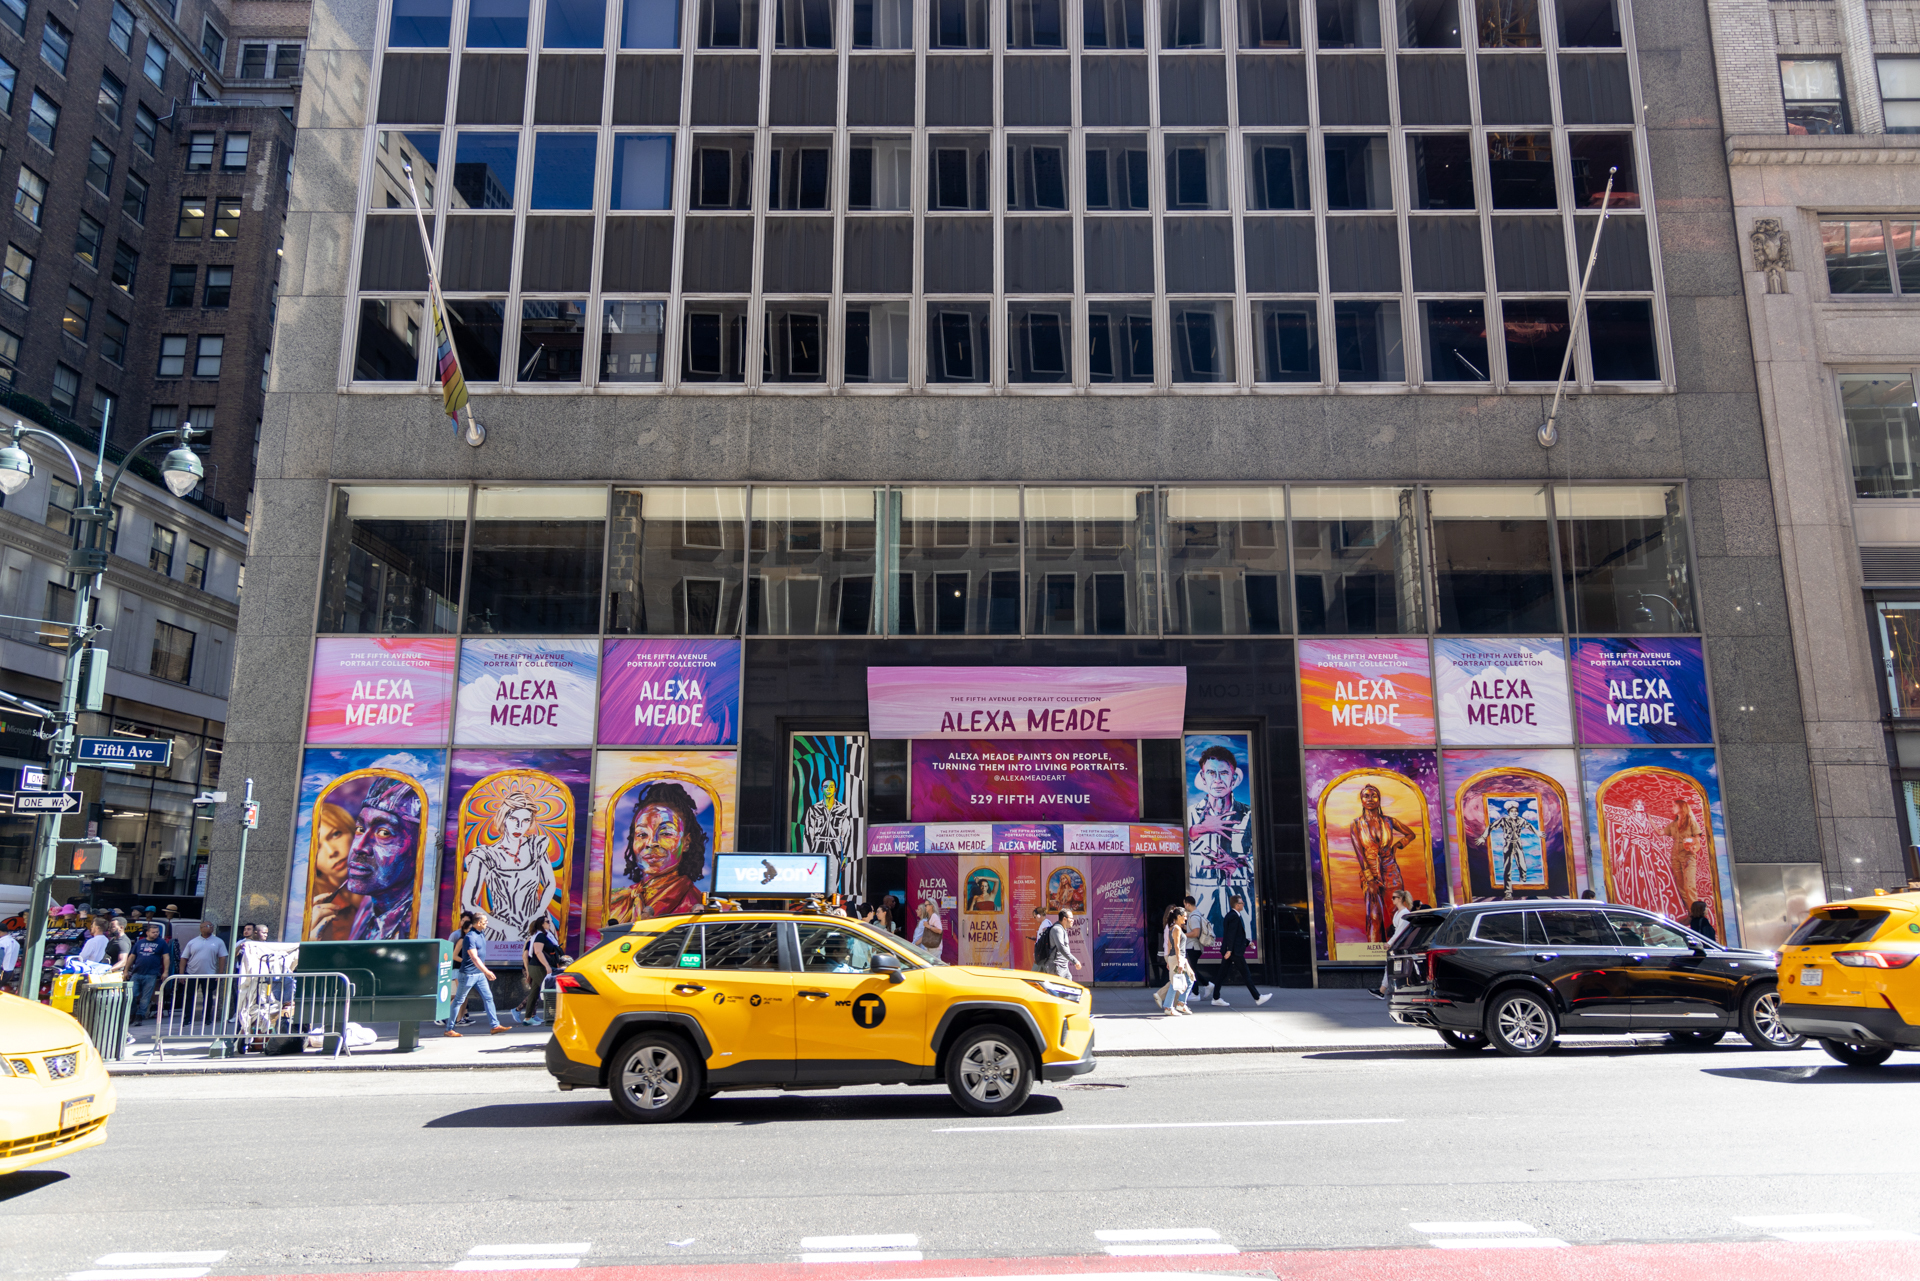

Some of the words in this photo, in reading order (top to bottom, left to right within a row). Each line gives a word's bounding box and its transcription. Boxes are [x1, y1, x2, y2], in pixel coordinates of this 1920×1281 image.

[352, 679, 414, 700] ALEXA
[496, 679, 558, 701] ALEXA
[640, 679, 701, 701] ALEXA
[1335, 679, 1397, 701] ALEXA
[1471, 678, 1533, 700] ALEXA
[1609, 678, 1672, 700] ALEXA
[346, 703, 415, 726] MEADE
[491, 704, 559, 727] MEADE
[635, 704, 703, 727] MEADE
[941, 710, 1016, 732] ALEXA
[1027, 709, 1111, 732] MEADE
[1332, 704, 1401, 726] MEADE
[1468, 703, 1537, 726] MEADE
[1606, 703, 1677, 726] MEADE
[7, 725, 31, 736] Microsoft
[93, 744, 124, 757] Fifth
[128, 746, 153, 758] Ave
[1073, 753, 1111, 761] PEOPLE,
[979, 763, 1005, 771] THEM
[1070, 763, 1128, 771] PORTRAITS.
[32, 774, 45, 784] ONE
[24, 799, 43, 807] ONE
[52, 798, 71, 807] WAY
[970, 795, 993, 804] 529
[997, 795, 1034, 804] FIFTH
[1039, 795, 1090, 804] AVENUE
[872, 842, 892, 852] ALEXA
[895, 841, 919, 851] MEADE
[931, 842, 955, 851] ALEXA
[958, 840, 986, 850] MEADE
[999, 841, 1025, 851] ALEXA
[1028, 840, 1057, 851] MEADE
[1070, 841, 1095, 851] ALEXA
[1099, 841, 1124, 851] MEADE
[1136, 842, 1157, 851] ALEXA
[1159, 842, 1180, 852] MEADE
[734, 868, 808, 881] verzon
[919, 878, 947, 888] ALEXA
[1097, 876, 1134, 895] WONDERLAND
[917, 889, 948, 900] MEADE
[1105, 886, 1130, 899] DREAMS
[970, 921, 998, 930] ALEXA
[968, 932, 998, 943] MEADE
[859, 1000, 879, 1025] T
